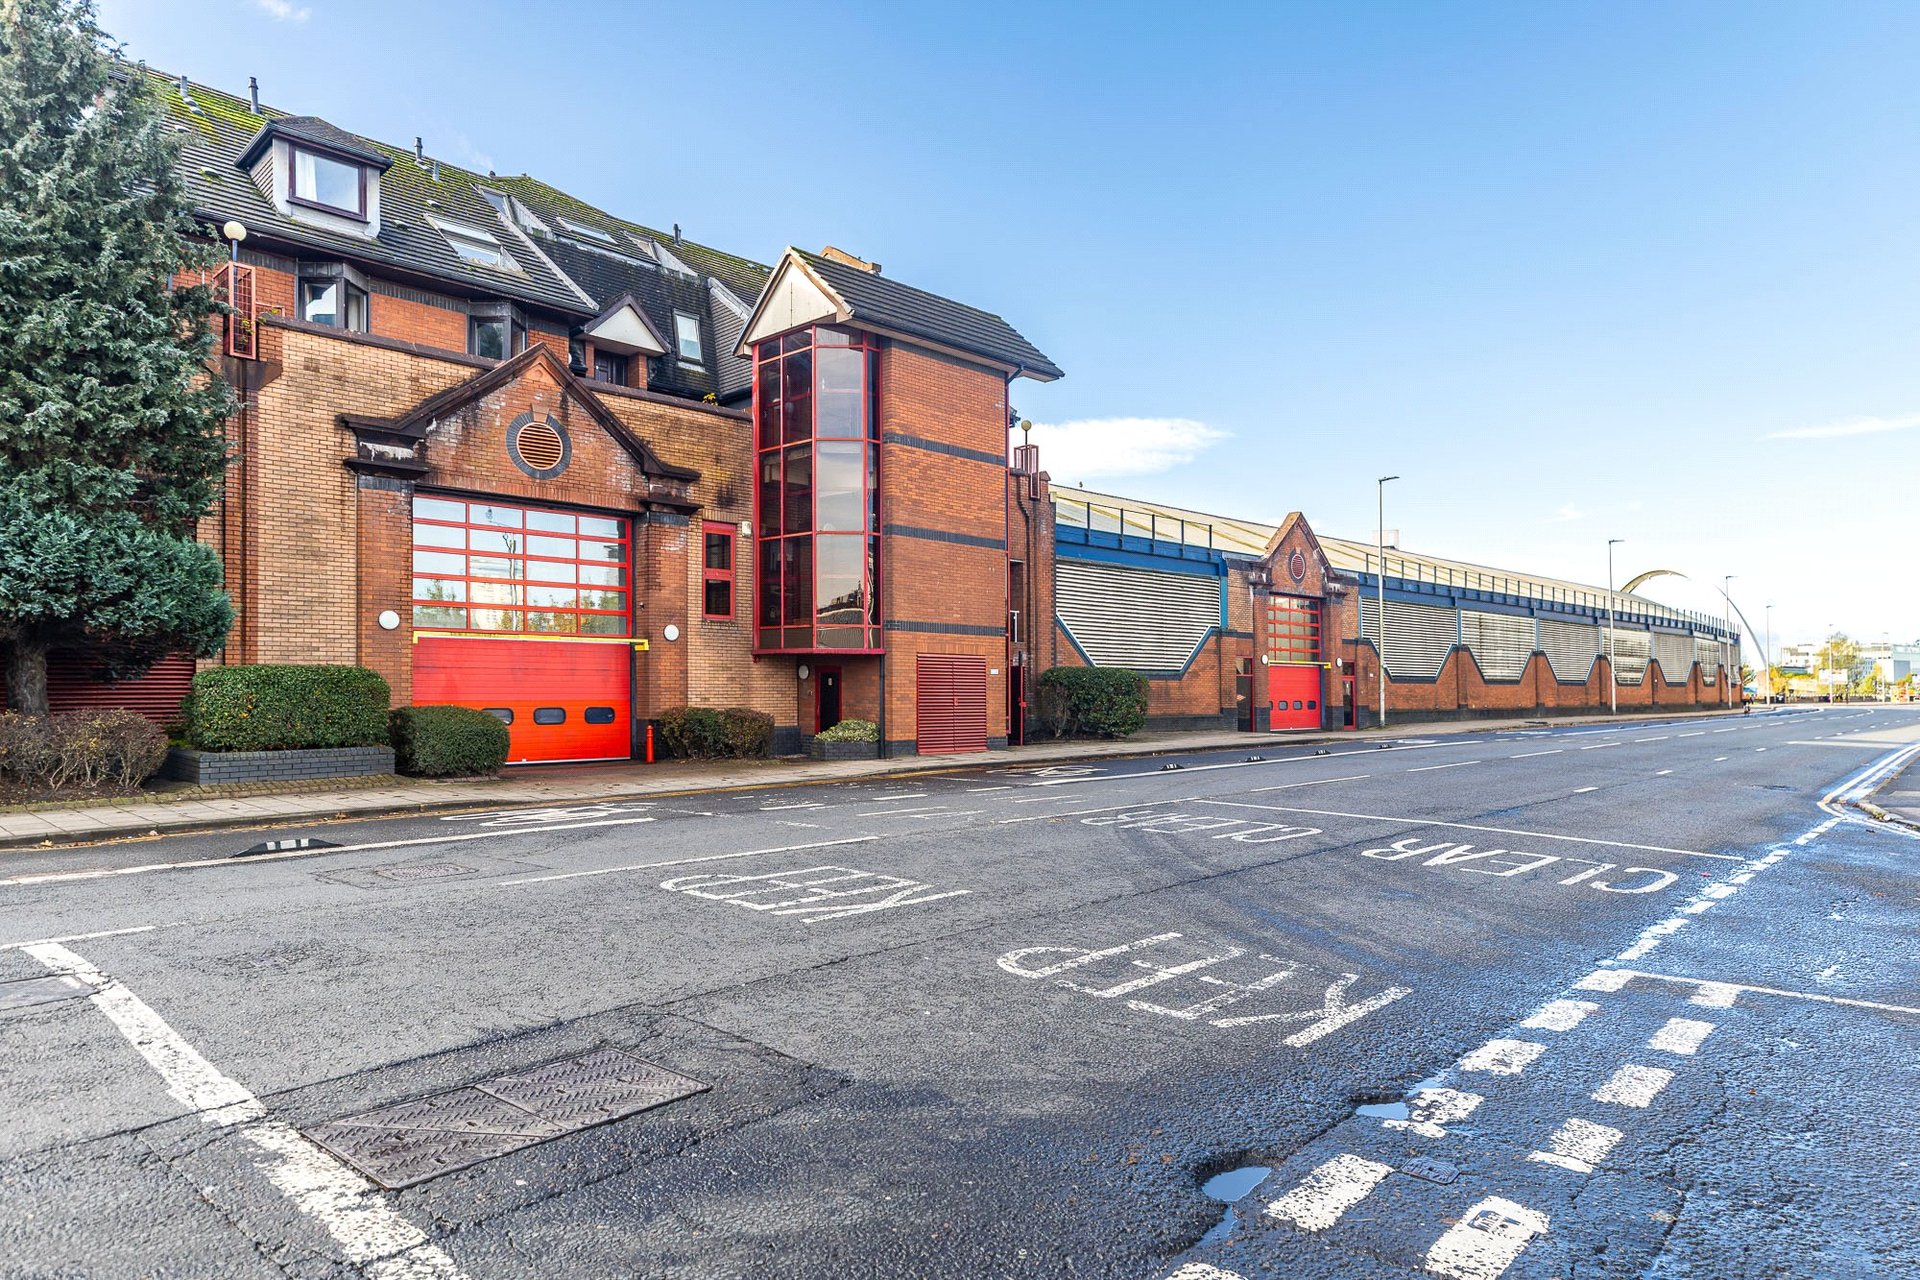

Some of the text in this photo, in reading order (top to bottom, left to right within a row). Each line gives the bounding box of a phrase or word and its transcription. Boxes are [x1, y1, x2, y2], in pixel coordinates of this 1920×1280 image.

[1081, 811, 1323, 843] CLEAR
[659, 865, 973, 924] KEEP
[1361, 838, 1679, 894] CLEAR
[996, 932, 1413, 1047] KEEP
